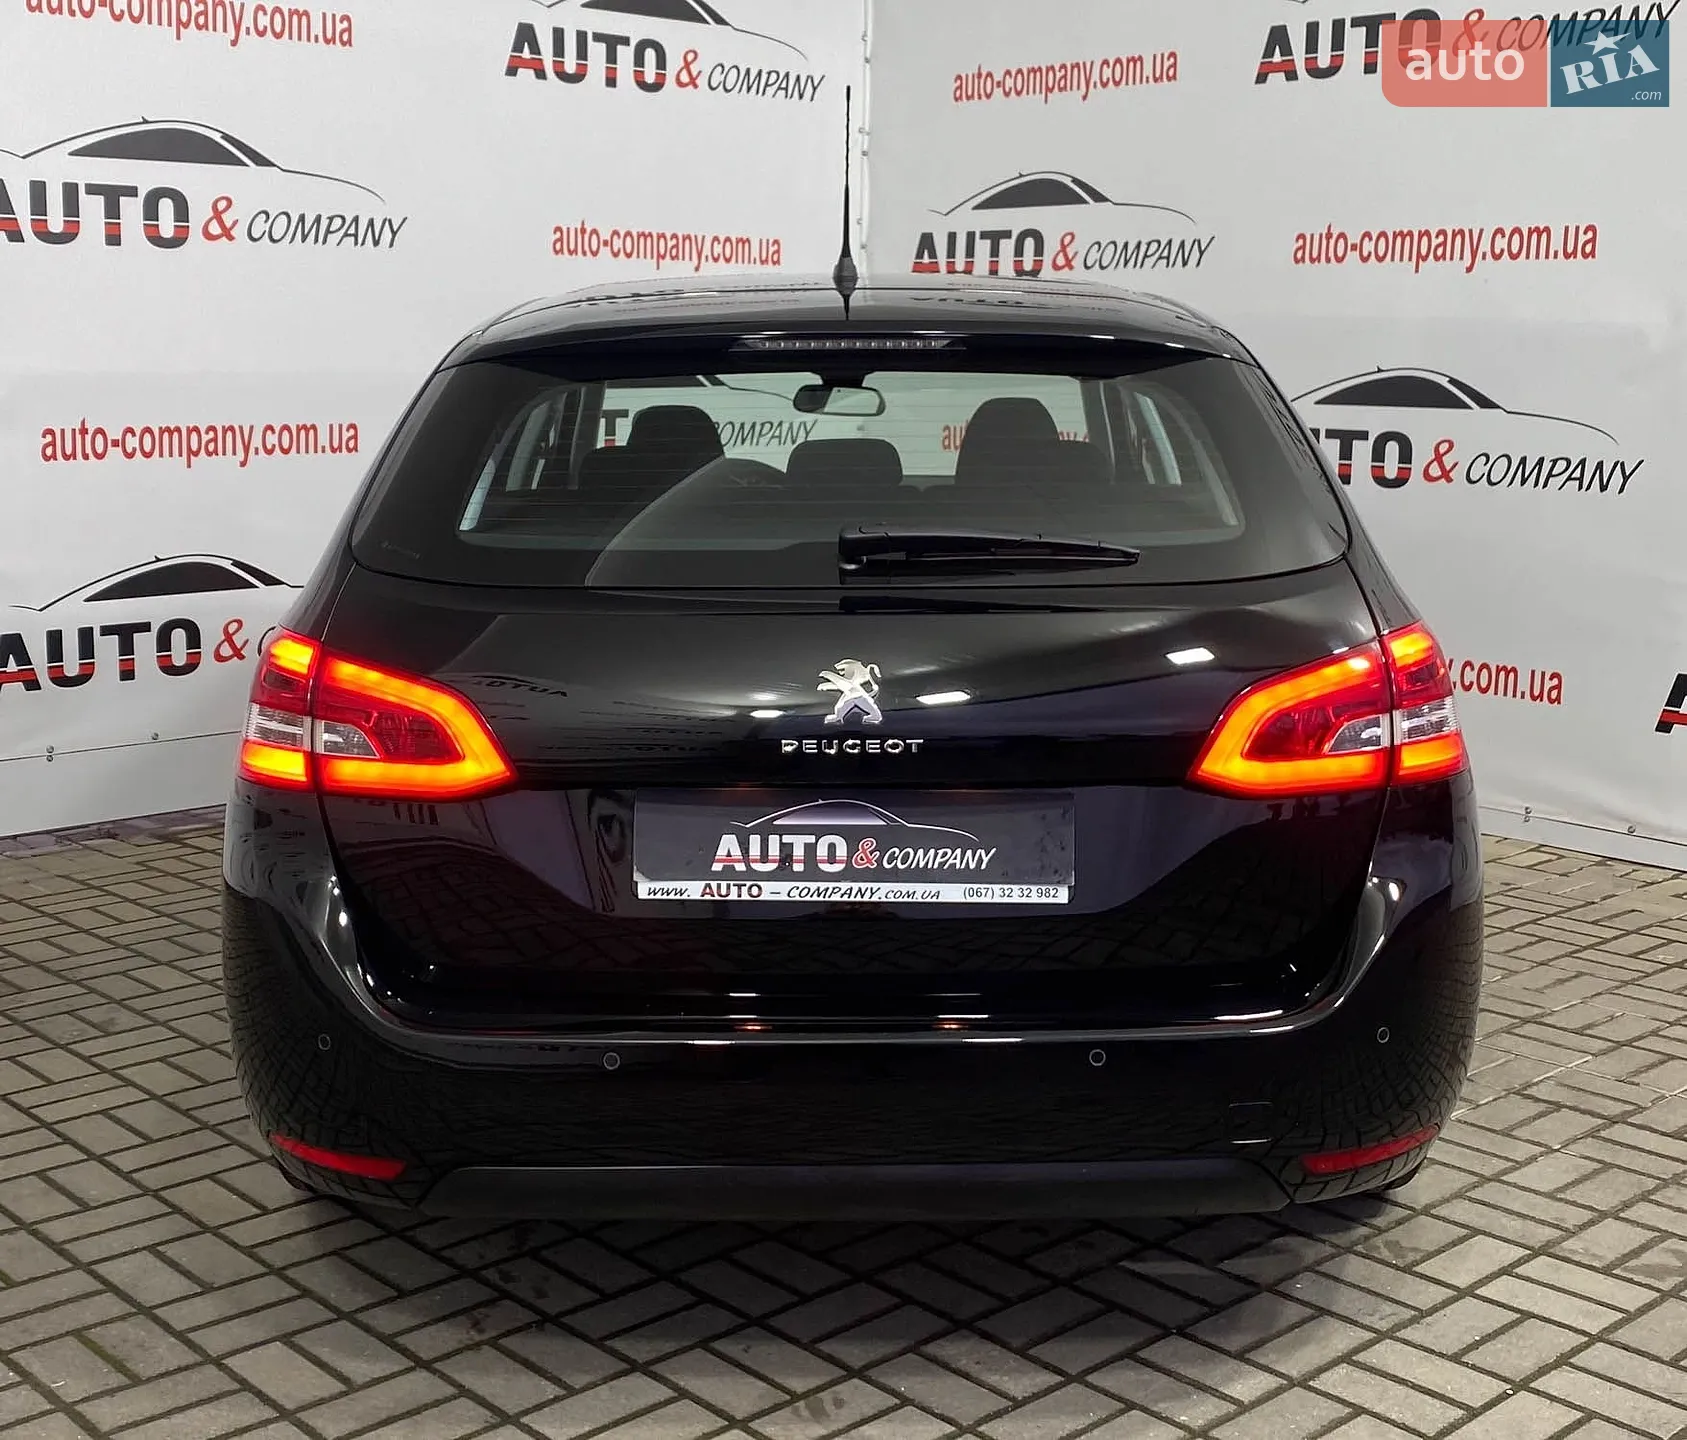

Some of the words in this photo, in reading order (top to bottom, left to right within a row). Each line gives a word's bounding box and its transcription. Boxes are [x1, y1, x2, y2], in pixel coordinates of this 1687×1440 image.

[505, 22, 667, 93] AUTO
[675, 50, 702, 89] &
[707, 63, 825, 102] COMPANY
[1254, 8, 1442, 84] AUTO
[953, 50, 1178, 103] auto-company.com.ua
[201, 196, 239, 243] &
[246, 210, 408, 248] COMPANY
[552, 220, 781, 271] auto-company.com.ua
[911, 228, 1044, 277] AUTO
[1051, 231, 1079, 272] &
[1083, 236, 1215, 270] COMPANY
[1293, 223, 1598, 273] auto-company.com.ua
[41, 418, 359, 467] auto-company.com.ua
[714, 417, 818, 448] OMPANY
[1423, 439, 1459, 483] &
[1465, 452, 1644, 494] COMPANY
[214, 619, 249, 663] &
[781, 739, 924, 755] PEUGEOT
[711, 834, 848, 872] AUTO
[852, 837, 880, 869] &
[882, 847, 996, 870] COMPANY
[648, 886, 690, 897] www.
[700, 882, 763, 898] AUTO
[963, 887, 995, 900] (067)
[999, 887, 1013, 898] 32
[1018, 887, 1033, 898] 32
[1036, 887, 1059, 898] 982
